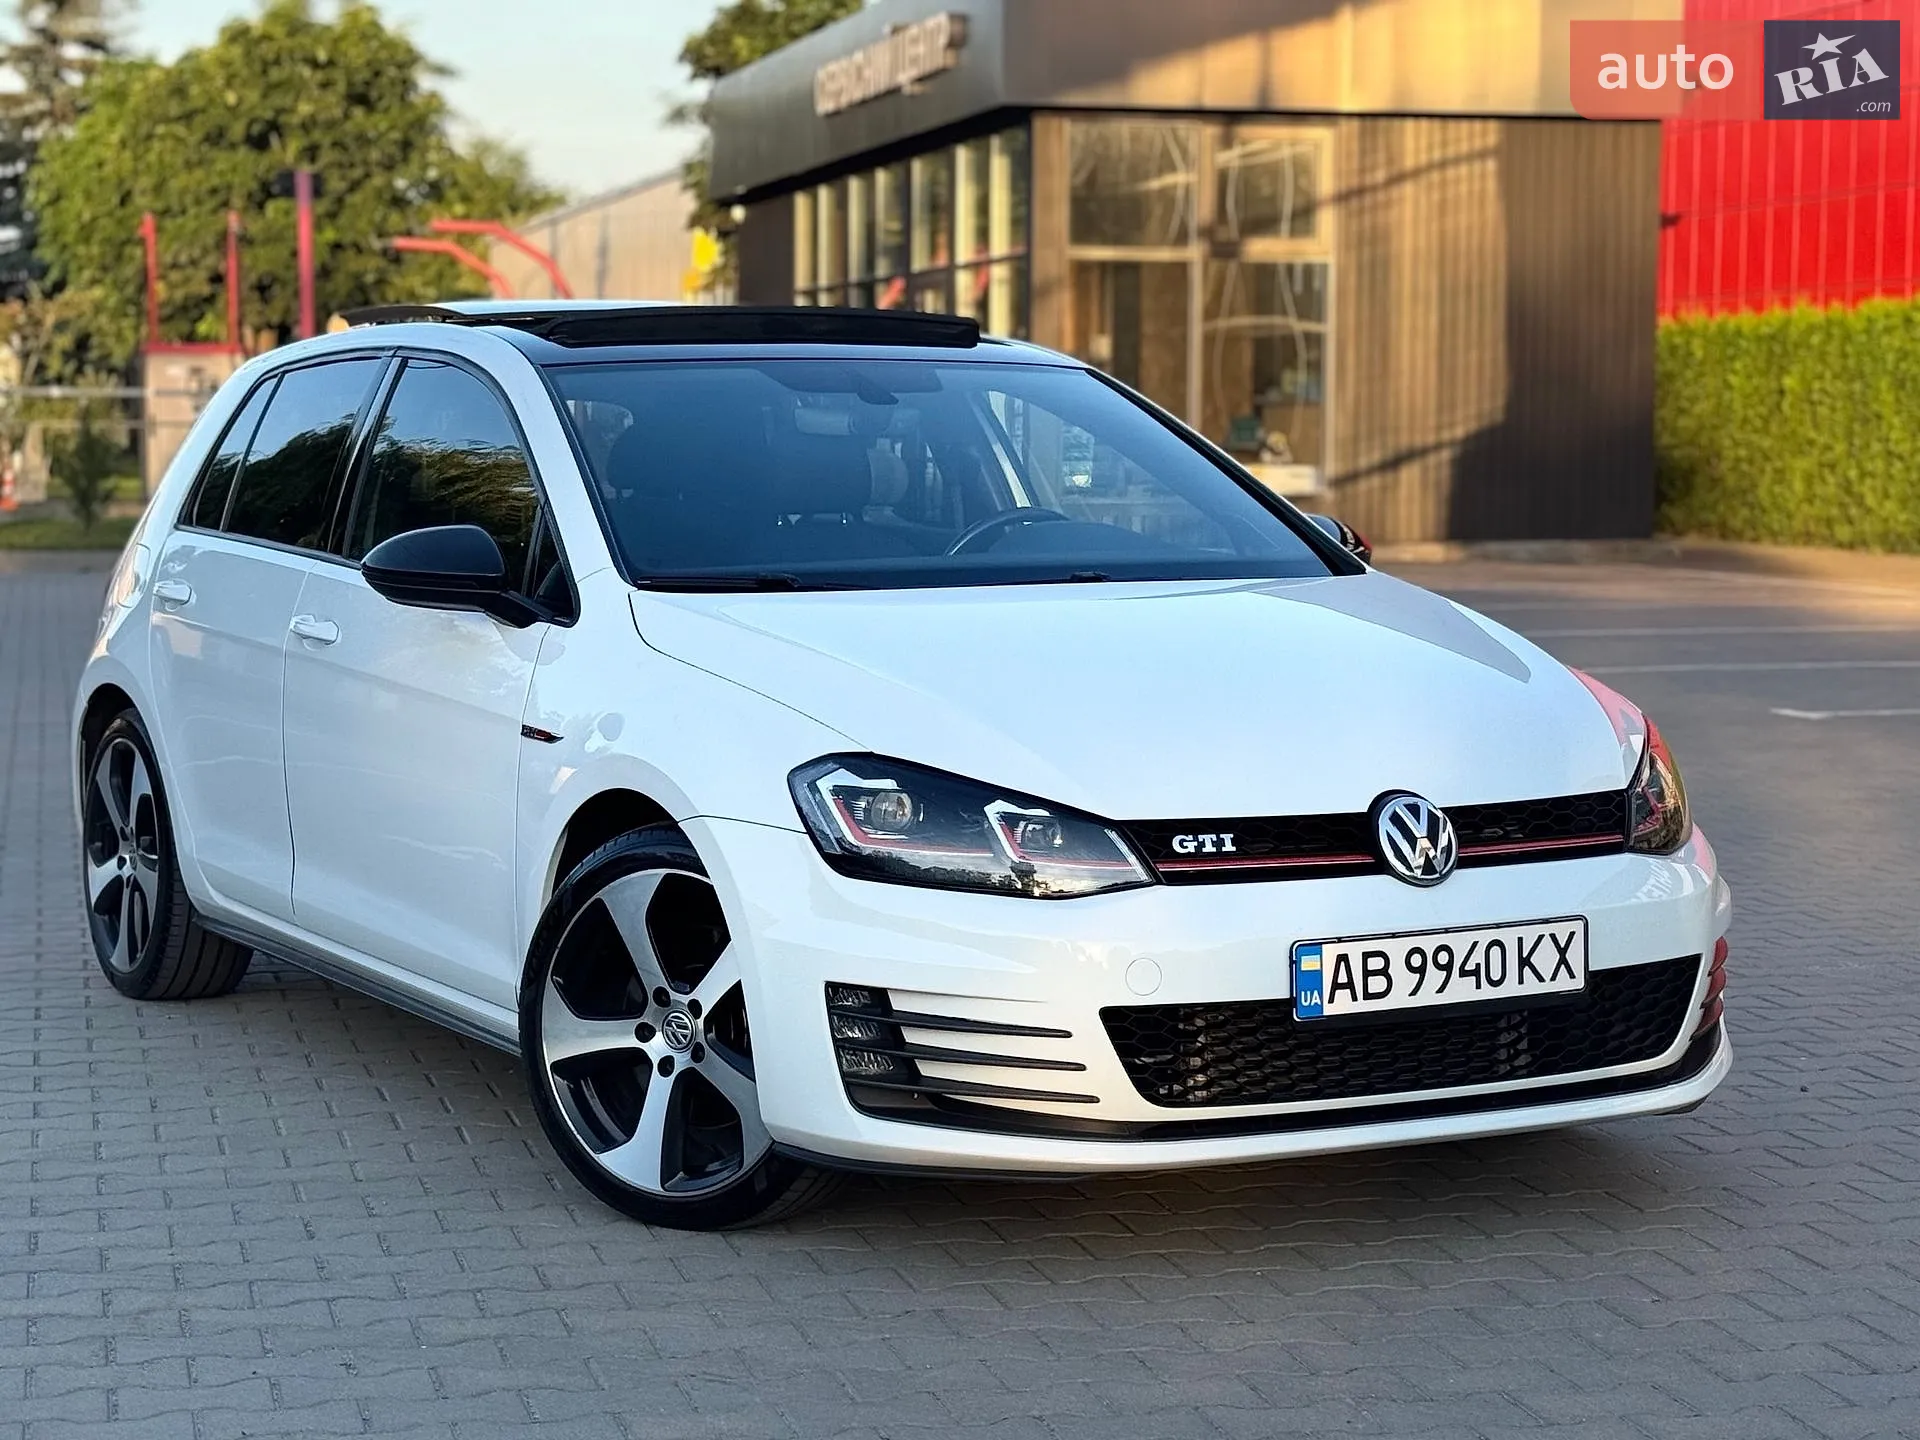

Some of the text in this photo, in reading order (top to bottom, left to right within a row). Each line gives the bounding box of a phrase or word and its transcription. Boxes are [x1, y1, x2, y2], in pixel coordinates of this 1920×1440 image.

[1172, 834, 1236, 853] GTI
[1328, 931, 1576, 1004] AB 9940 KX
[1301, 990, 1321, 1006] UA
